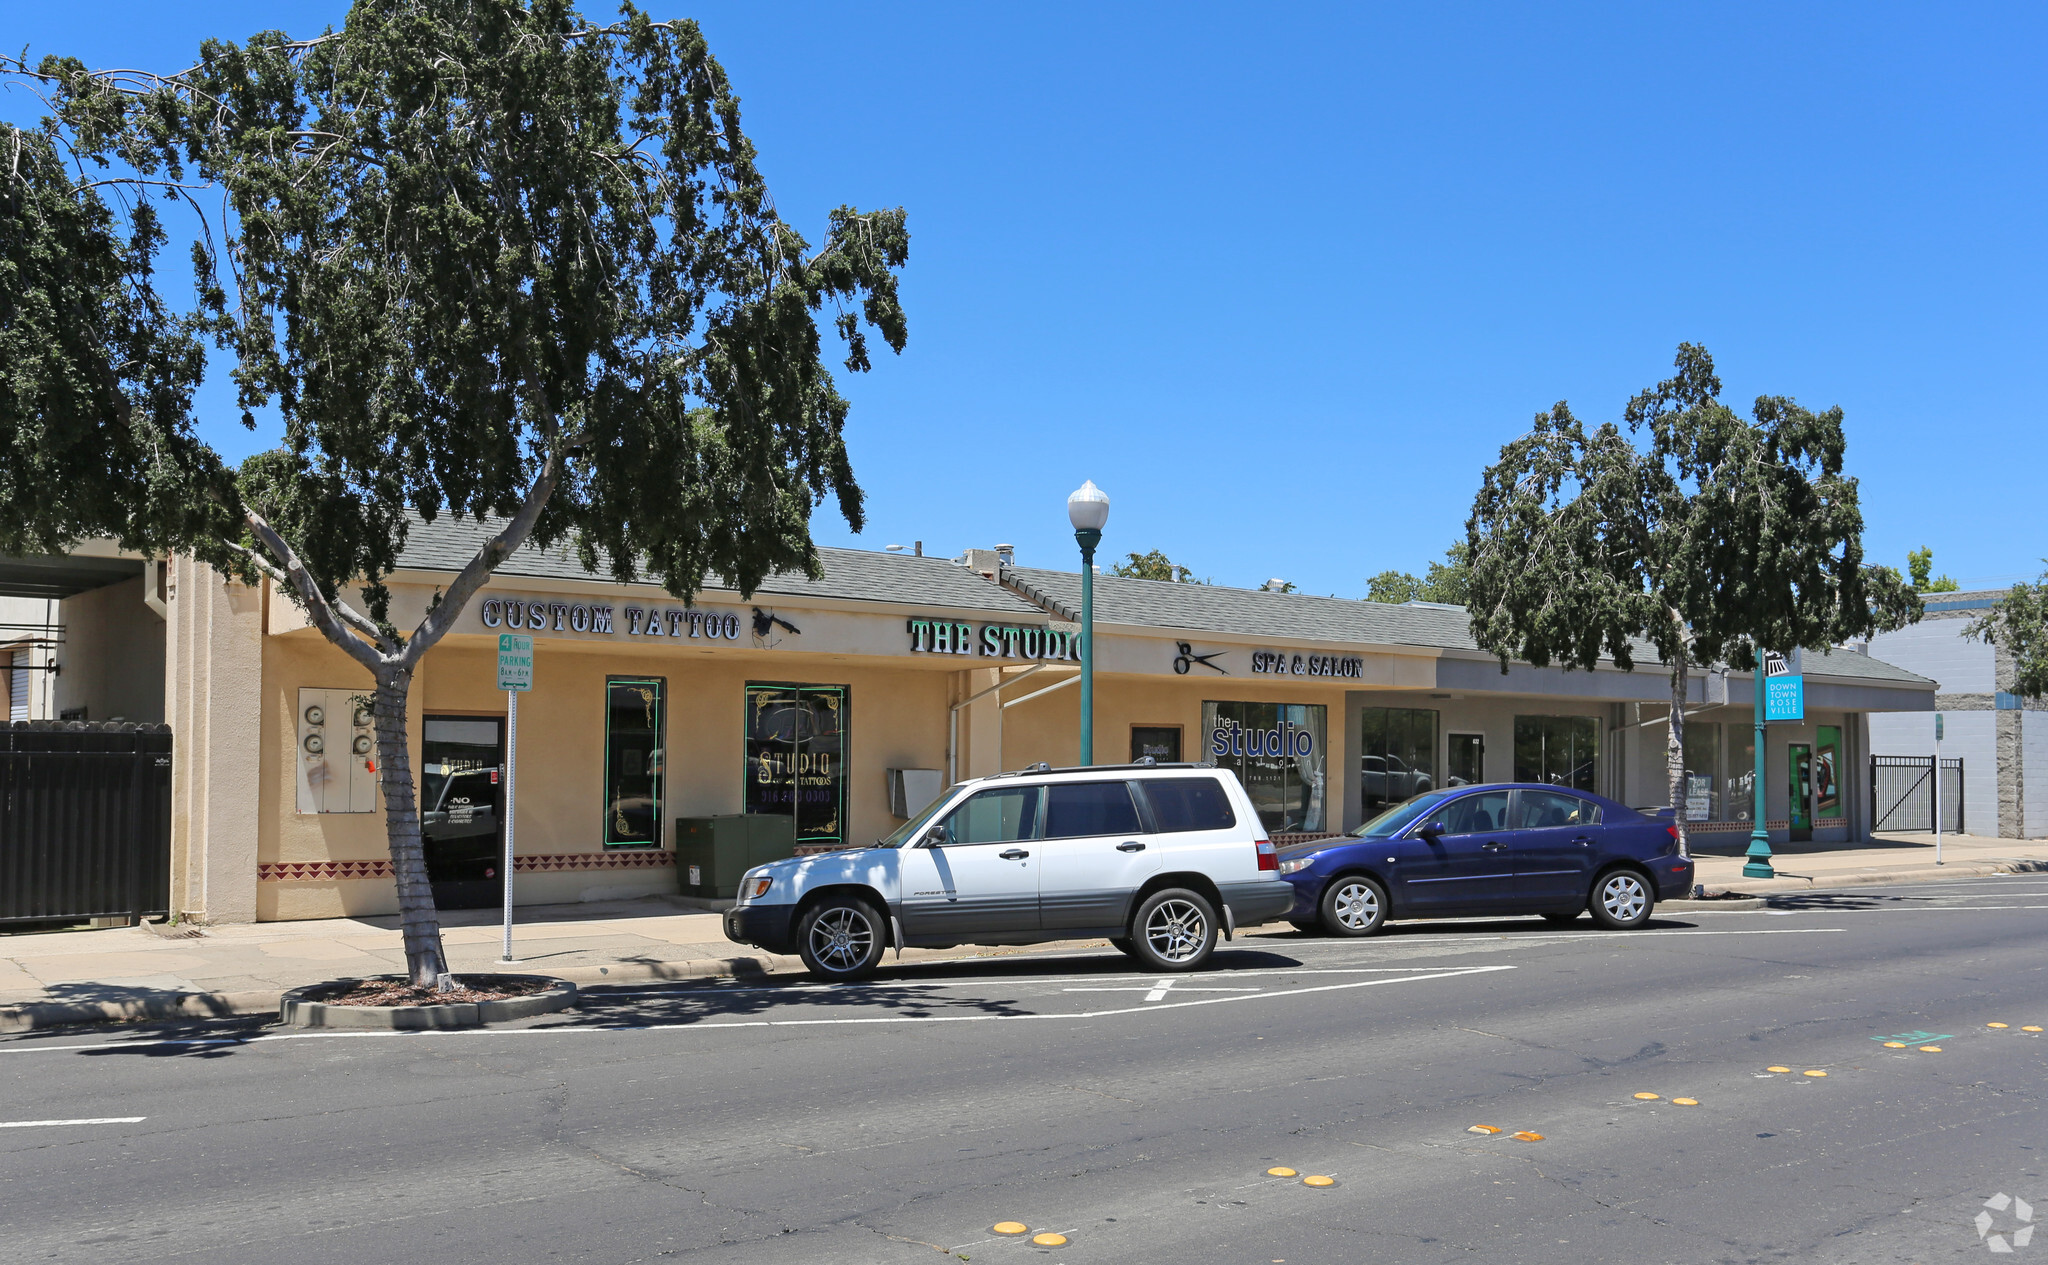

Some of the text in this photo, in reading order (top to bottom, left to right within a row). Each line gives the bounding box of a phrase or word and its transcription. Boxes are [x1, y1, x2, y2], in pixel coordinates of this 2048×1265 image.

[482, 598, 741, 641] CUSTOM TATTOO
[502, 636, 530, 650] 4 HOUR
[907, 619, 972, 655] THE
[500, 655, 531, 667] PARKING
[1252, 651, 1364, 679] SPA & SALON
[1769, 682, 1797, 691] DOWN
[1770, 691, 1797, 699] TOWN
[1770, 706, 1797, 714] VILLE
[1213, 714, 1231, 727] the
[1211, 720, 1313, 758] studio
[758, 751, 830, 784] STUDIO
[800, 776, 832, 786] TATTOOS
[1693, 778, 1706, 787] FOR
[1688, 787, 1709, 797] LEASE
